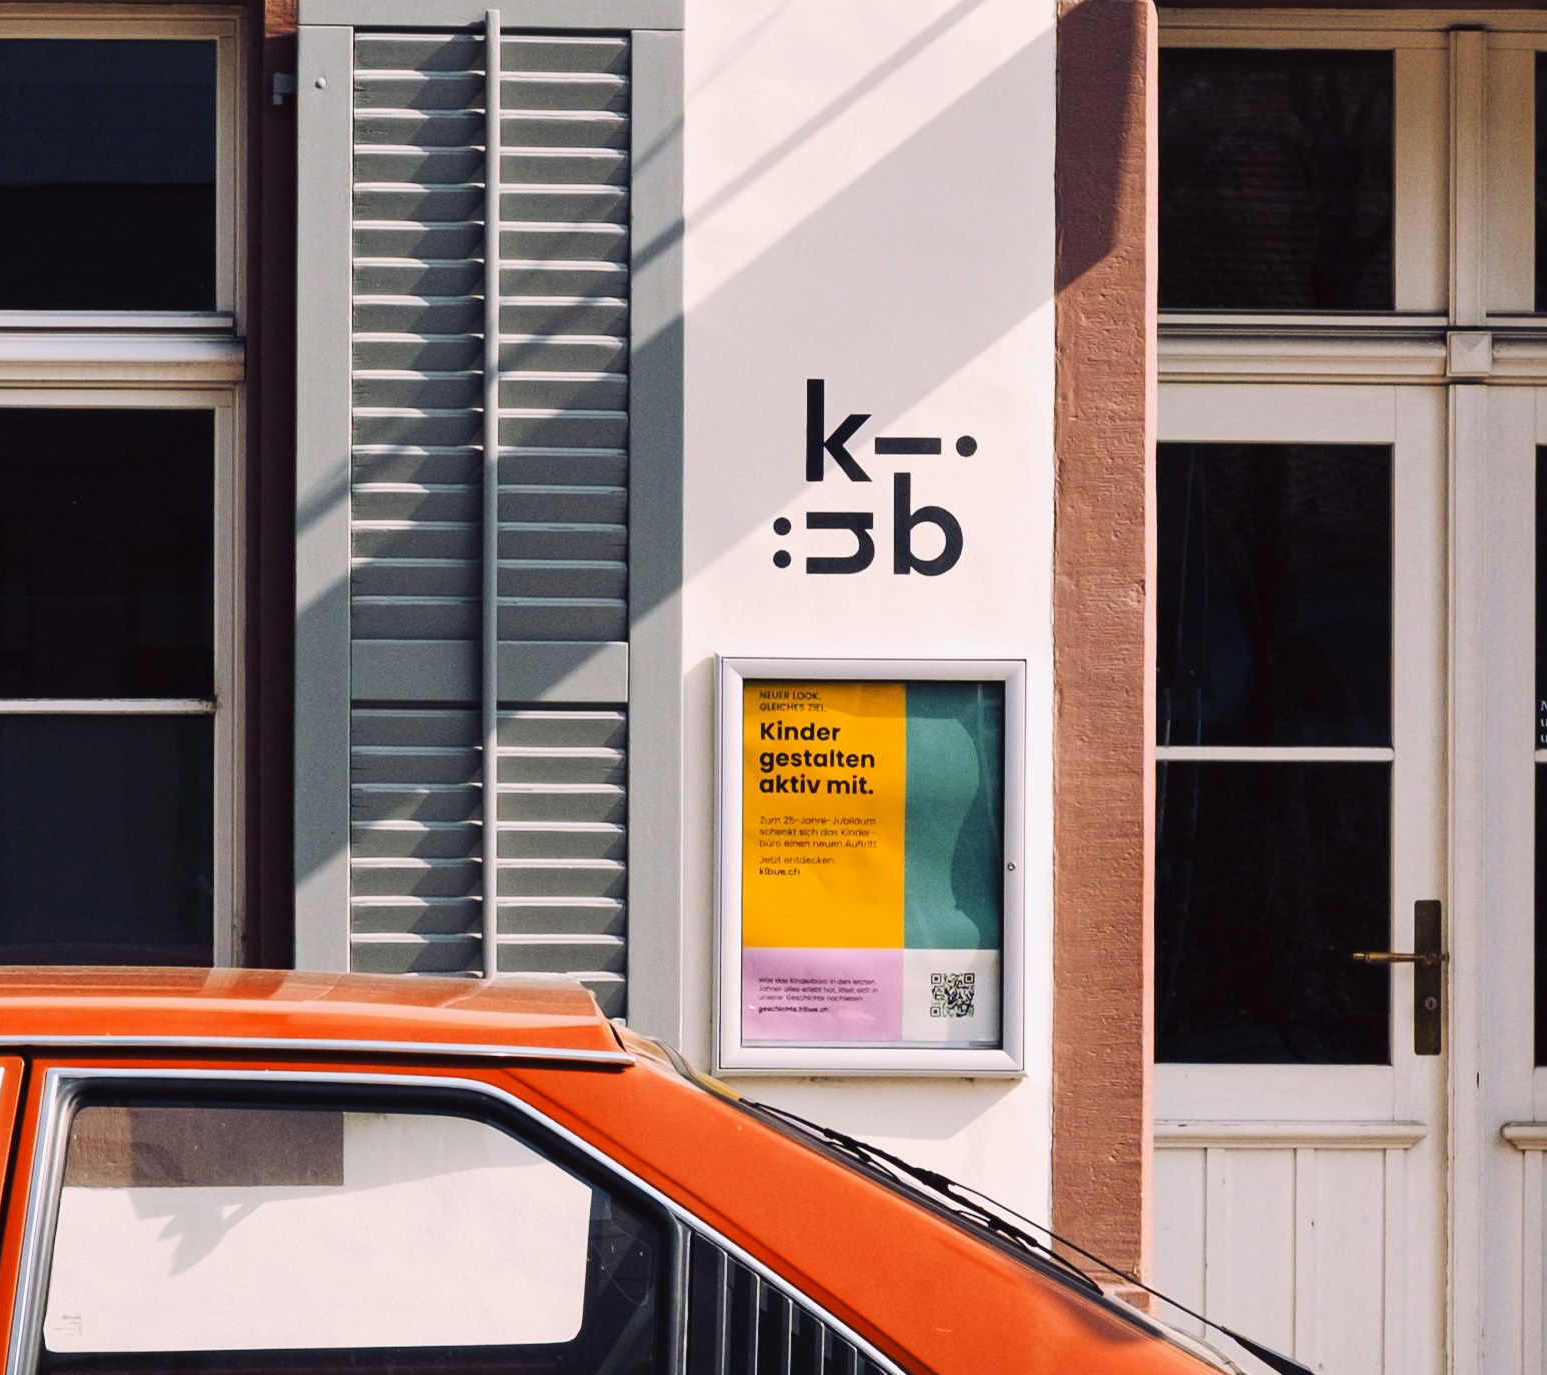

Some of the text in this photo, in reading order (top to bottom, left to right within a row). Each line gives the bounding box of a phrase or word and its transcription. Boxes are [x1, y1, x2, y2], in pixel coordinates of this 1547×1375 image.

[759, 690, 822, 701] NEUER LOOK.
[759, 702, 805, 712] GLEICHES
[760, 720, 842, 742] Kinder
[759, 749, 876, 774] gestalten
[759, 774, 874, 796] aktiv mit.
[760, 816, 781, 825] Zum
[759, 828, 797, 837] schenkt
[799, 828, 819, 837] sich
[820, 828, 838, 837] das
[759, 839, 782, 848] büro
[783, 840, 811, 848] einen
[812, 840, 843, 848] neuen
[759, 866, 801, 876] kibue.ch
